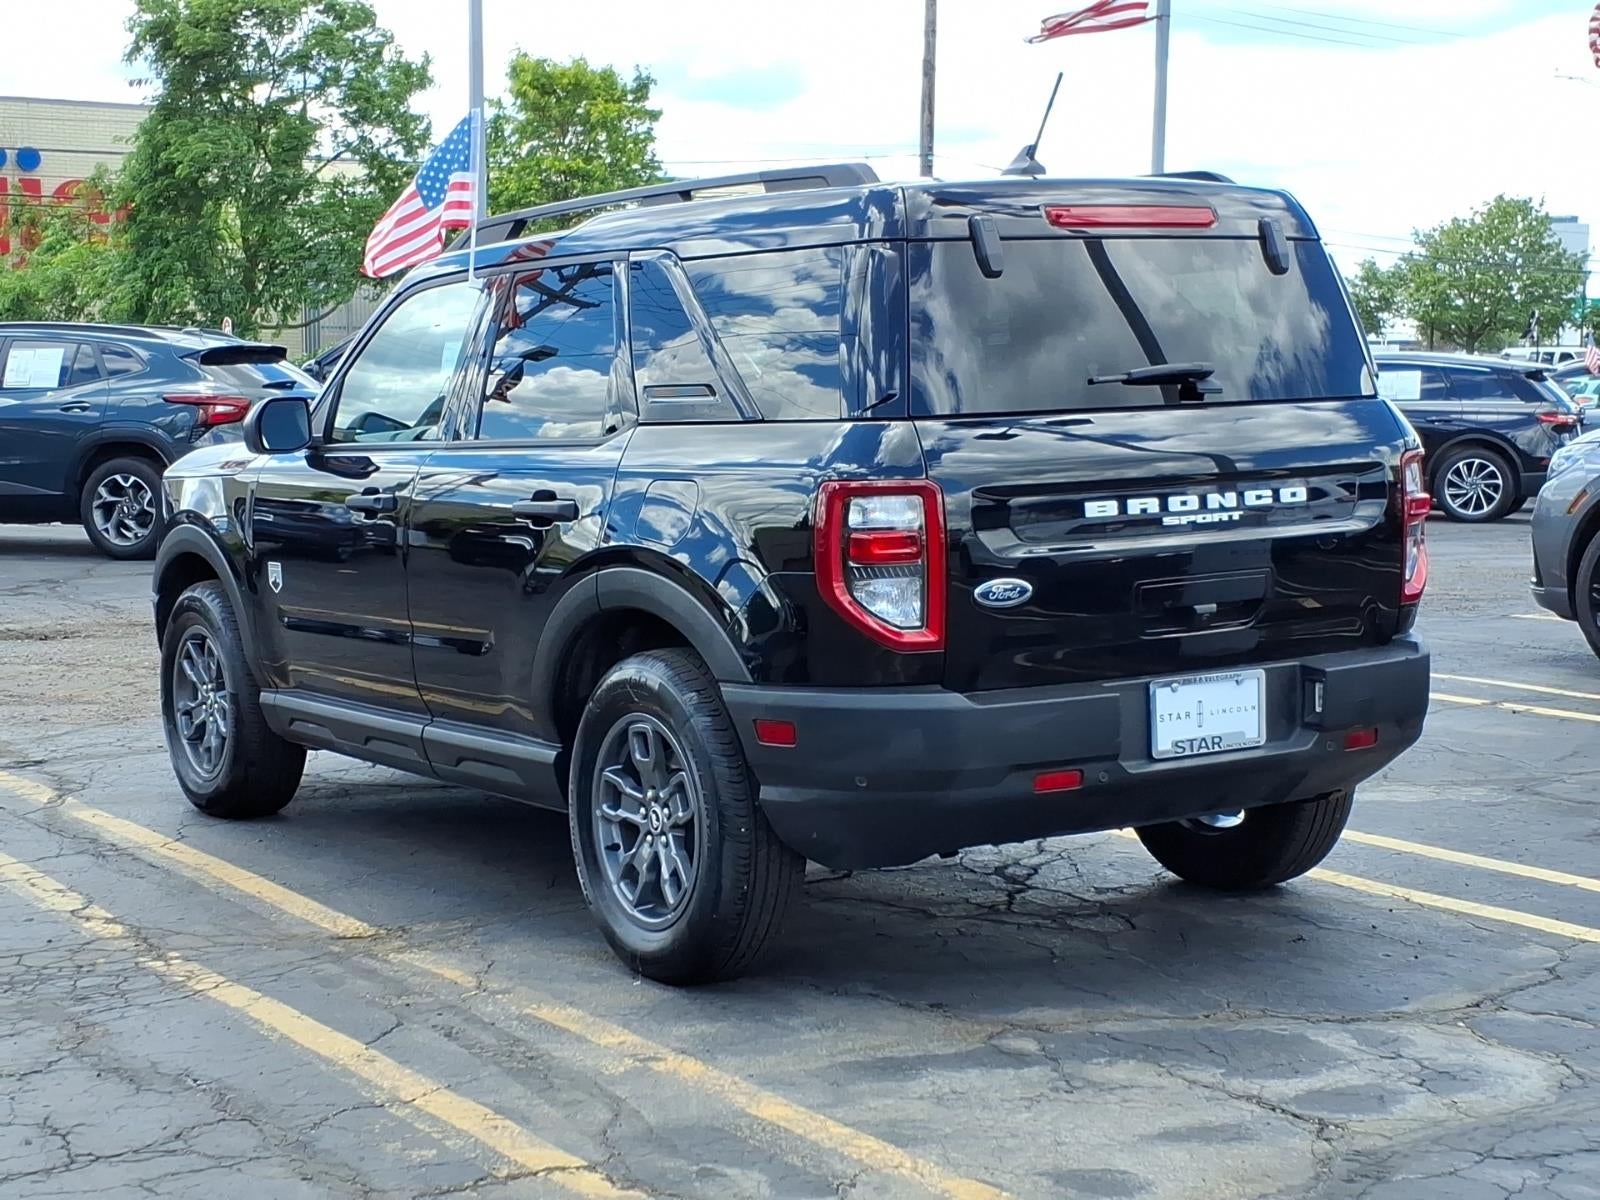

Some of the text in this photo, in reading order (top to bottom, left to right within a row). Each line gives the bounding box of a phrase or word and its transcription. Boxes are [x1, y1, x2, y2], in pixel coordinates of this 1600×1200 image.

[1083, 487, 1308, 518] BRONCO
[1162, 511, 1244, 526] SPORT
[988, 584, 1021, 600] Ford
[1159, 704, 1257, 723] STAR LINCOLN
[1174, 735, 1223, 755] STAR
